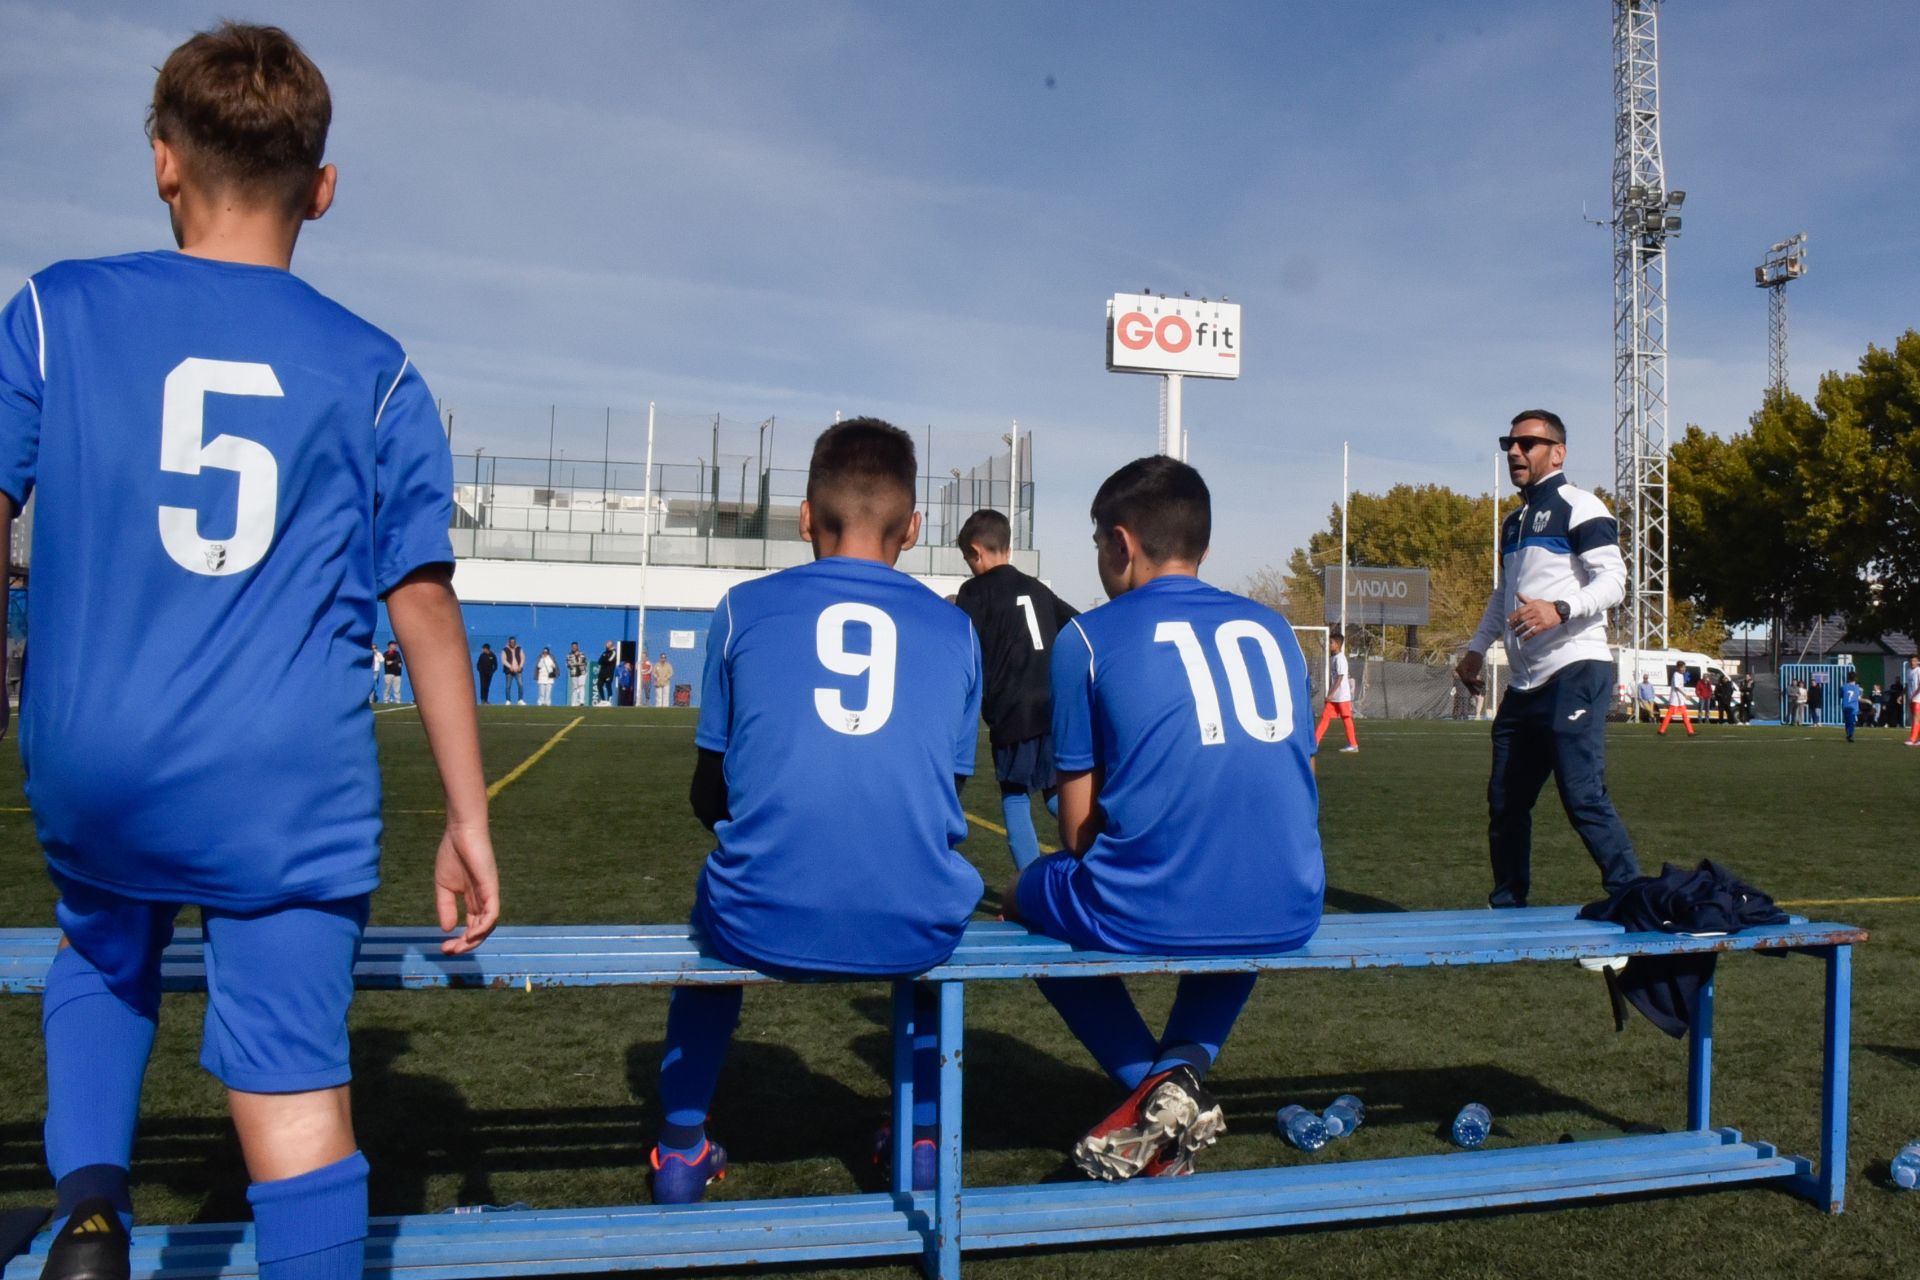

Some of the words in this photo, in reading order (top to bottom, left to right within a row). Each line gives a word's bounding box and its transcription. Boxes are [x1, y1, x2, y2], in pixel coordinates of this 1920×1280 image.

[159, 357, 285, 576] 5
[814, 602, 897, 735] 9
[1016, 595, 1044, 650] 1
[1153, 620, 1294, 745] 10
[1847, 690, 1854, 702] 7
